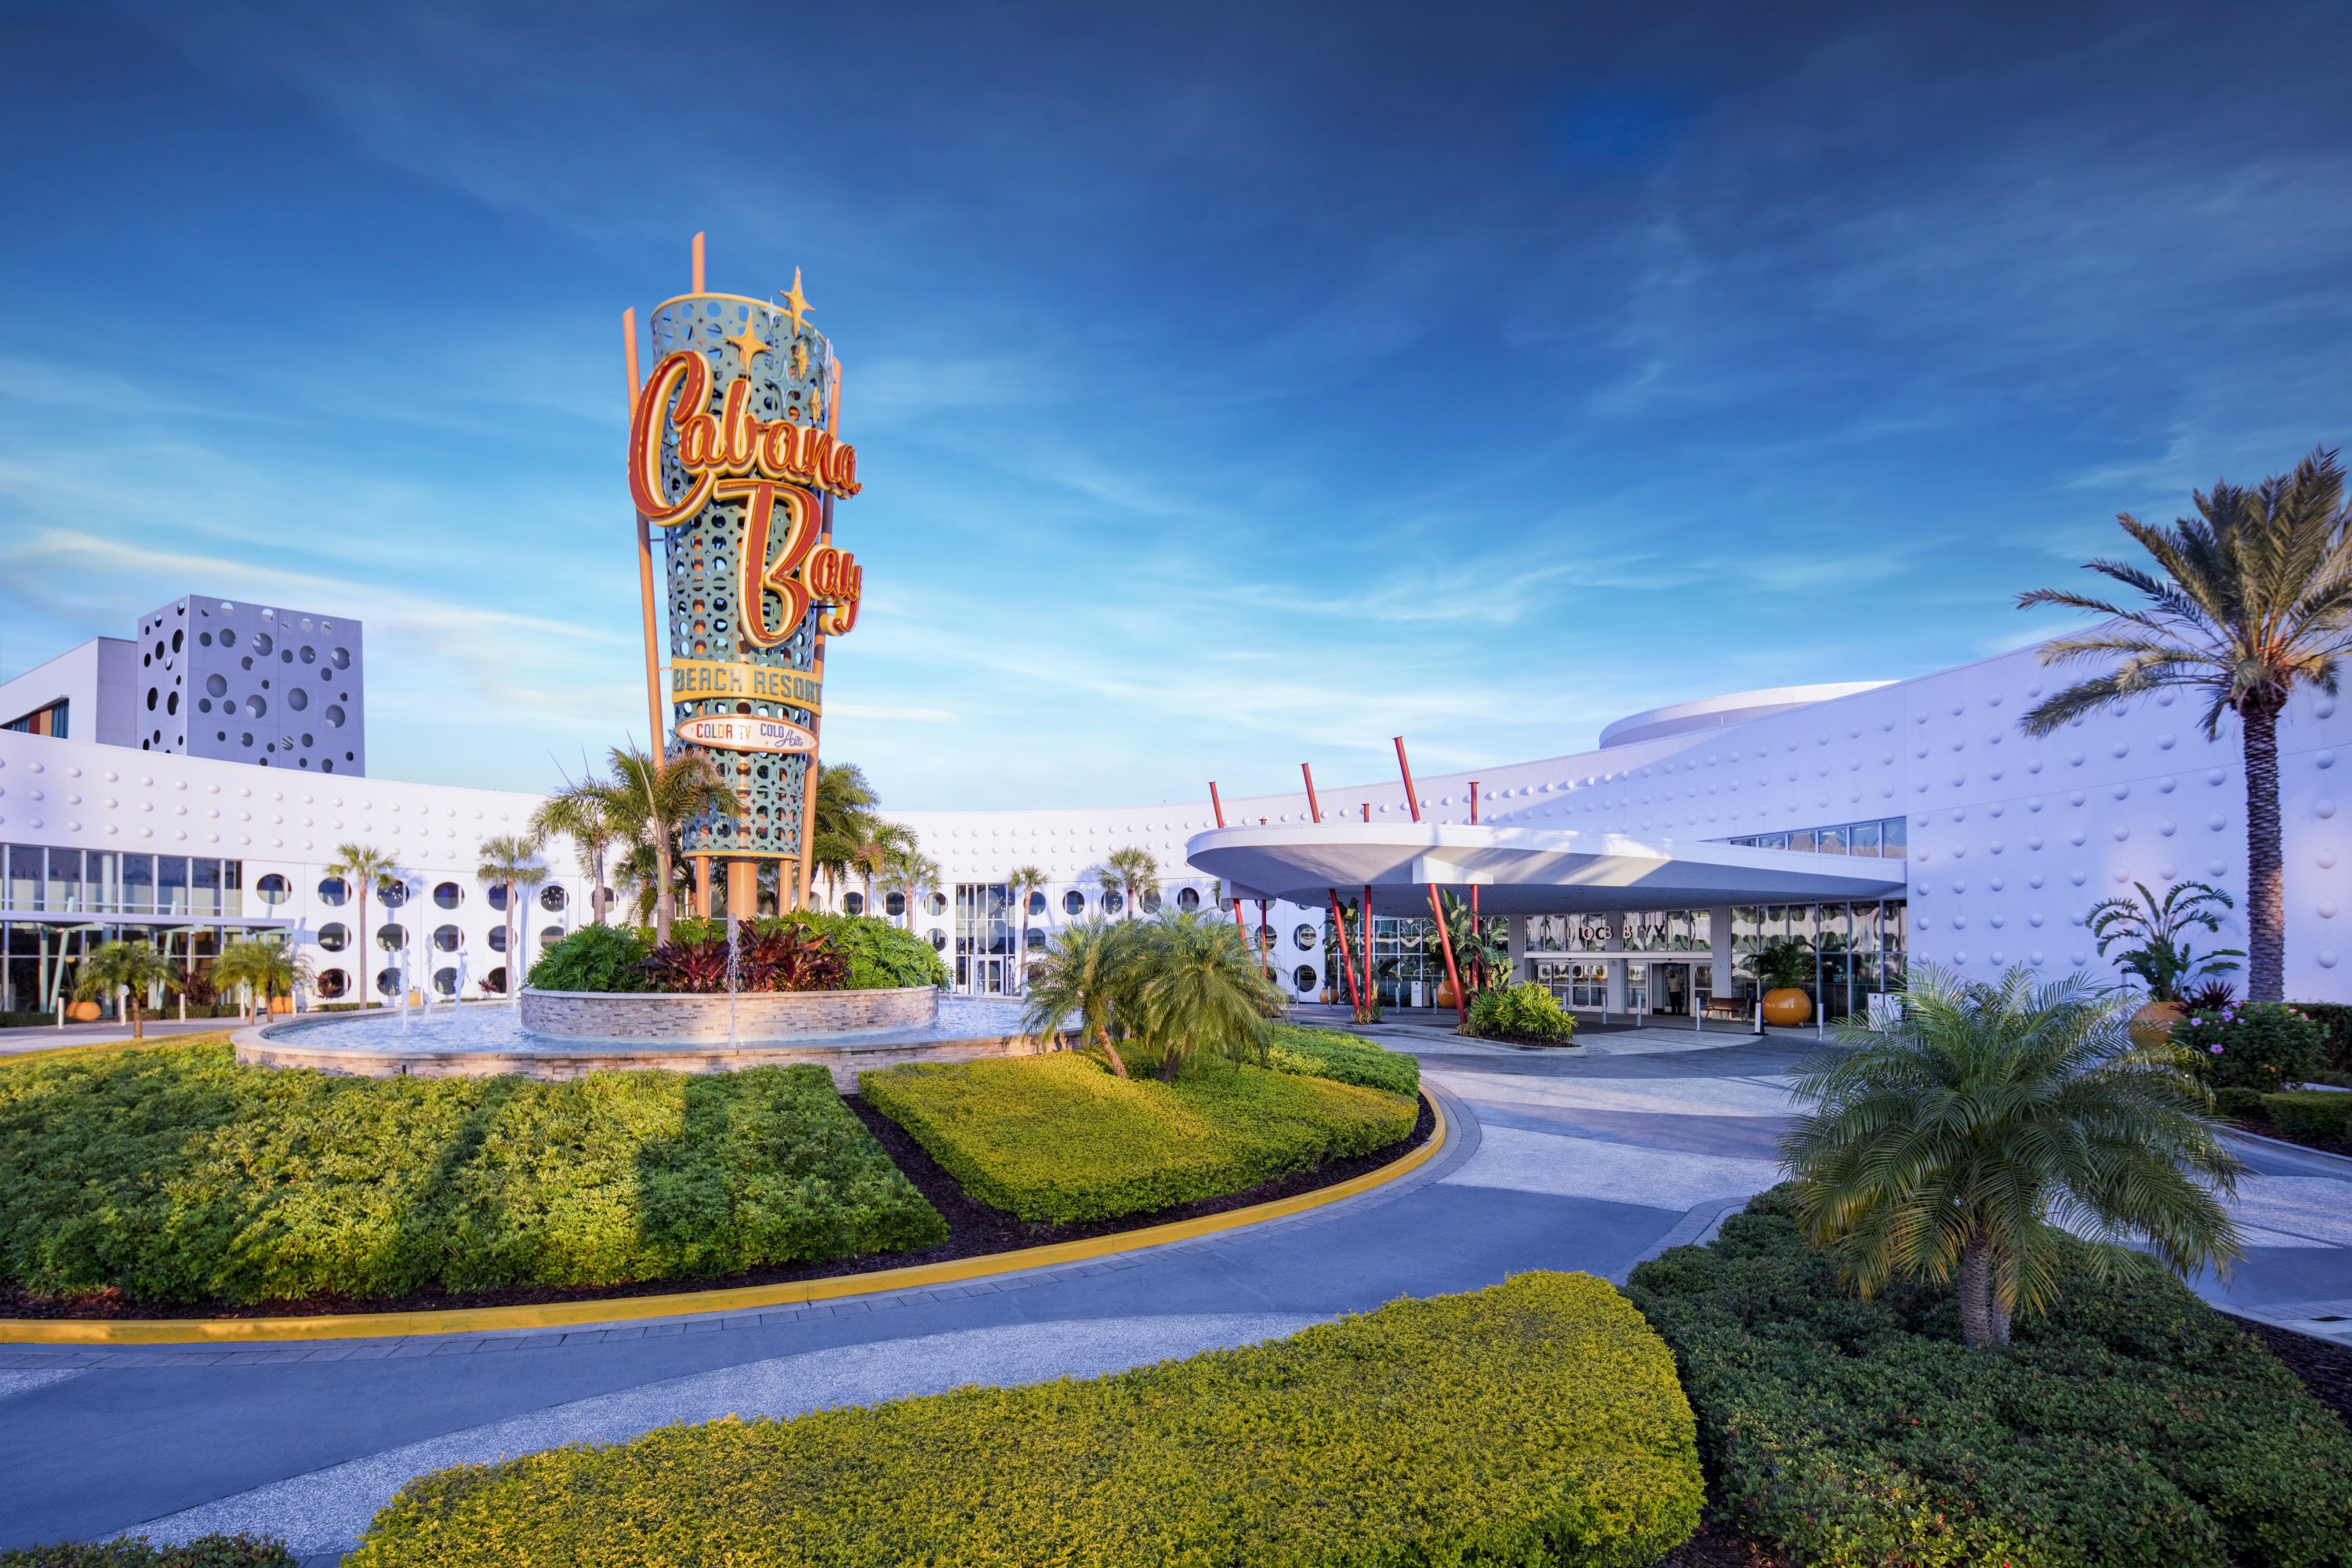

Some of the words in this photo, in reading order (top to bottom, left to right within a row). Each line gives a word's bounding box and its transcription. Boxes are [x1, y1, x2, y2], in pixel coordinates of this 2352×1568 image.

[628, 349, 864, 527] Cabana
[713, 477, 863, 649] Bay
[673, 667, 743, 692] BEACH
[753, 670, 822, 706] RESORT
[696, 723, 733, 739] COLOR
[739, 724, 751, 739] TV
[760, 723, 784, 738] COLD
